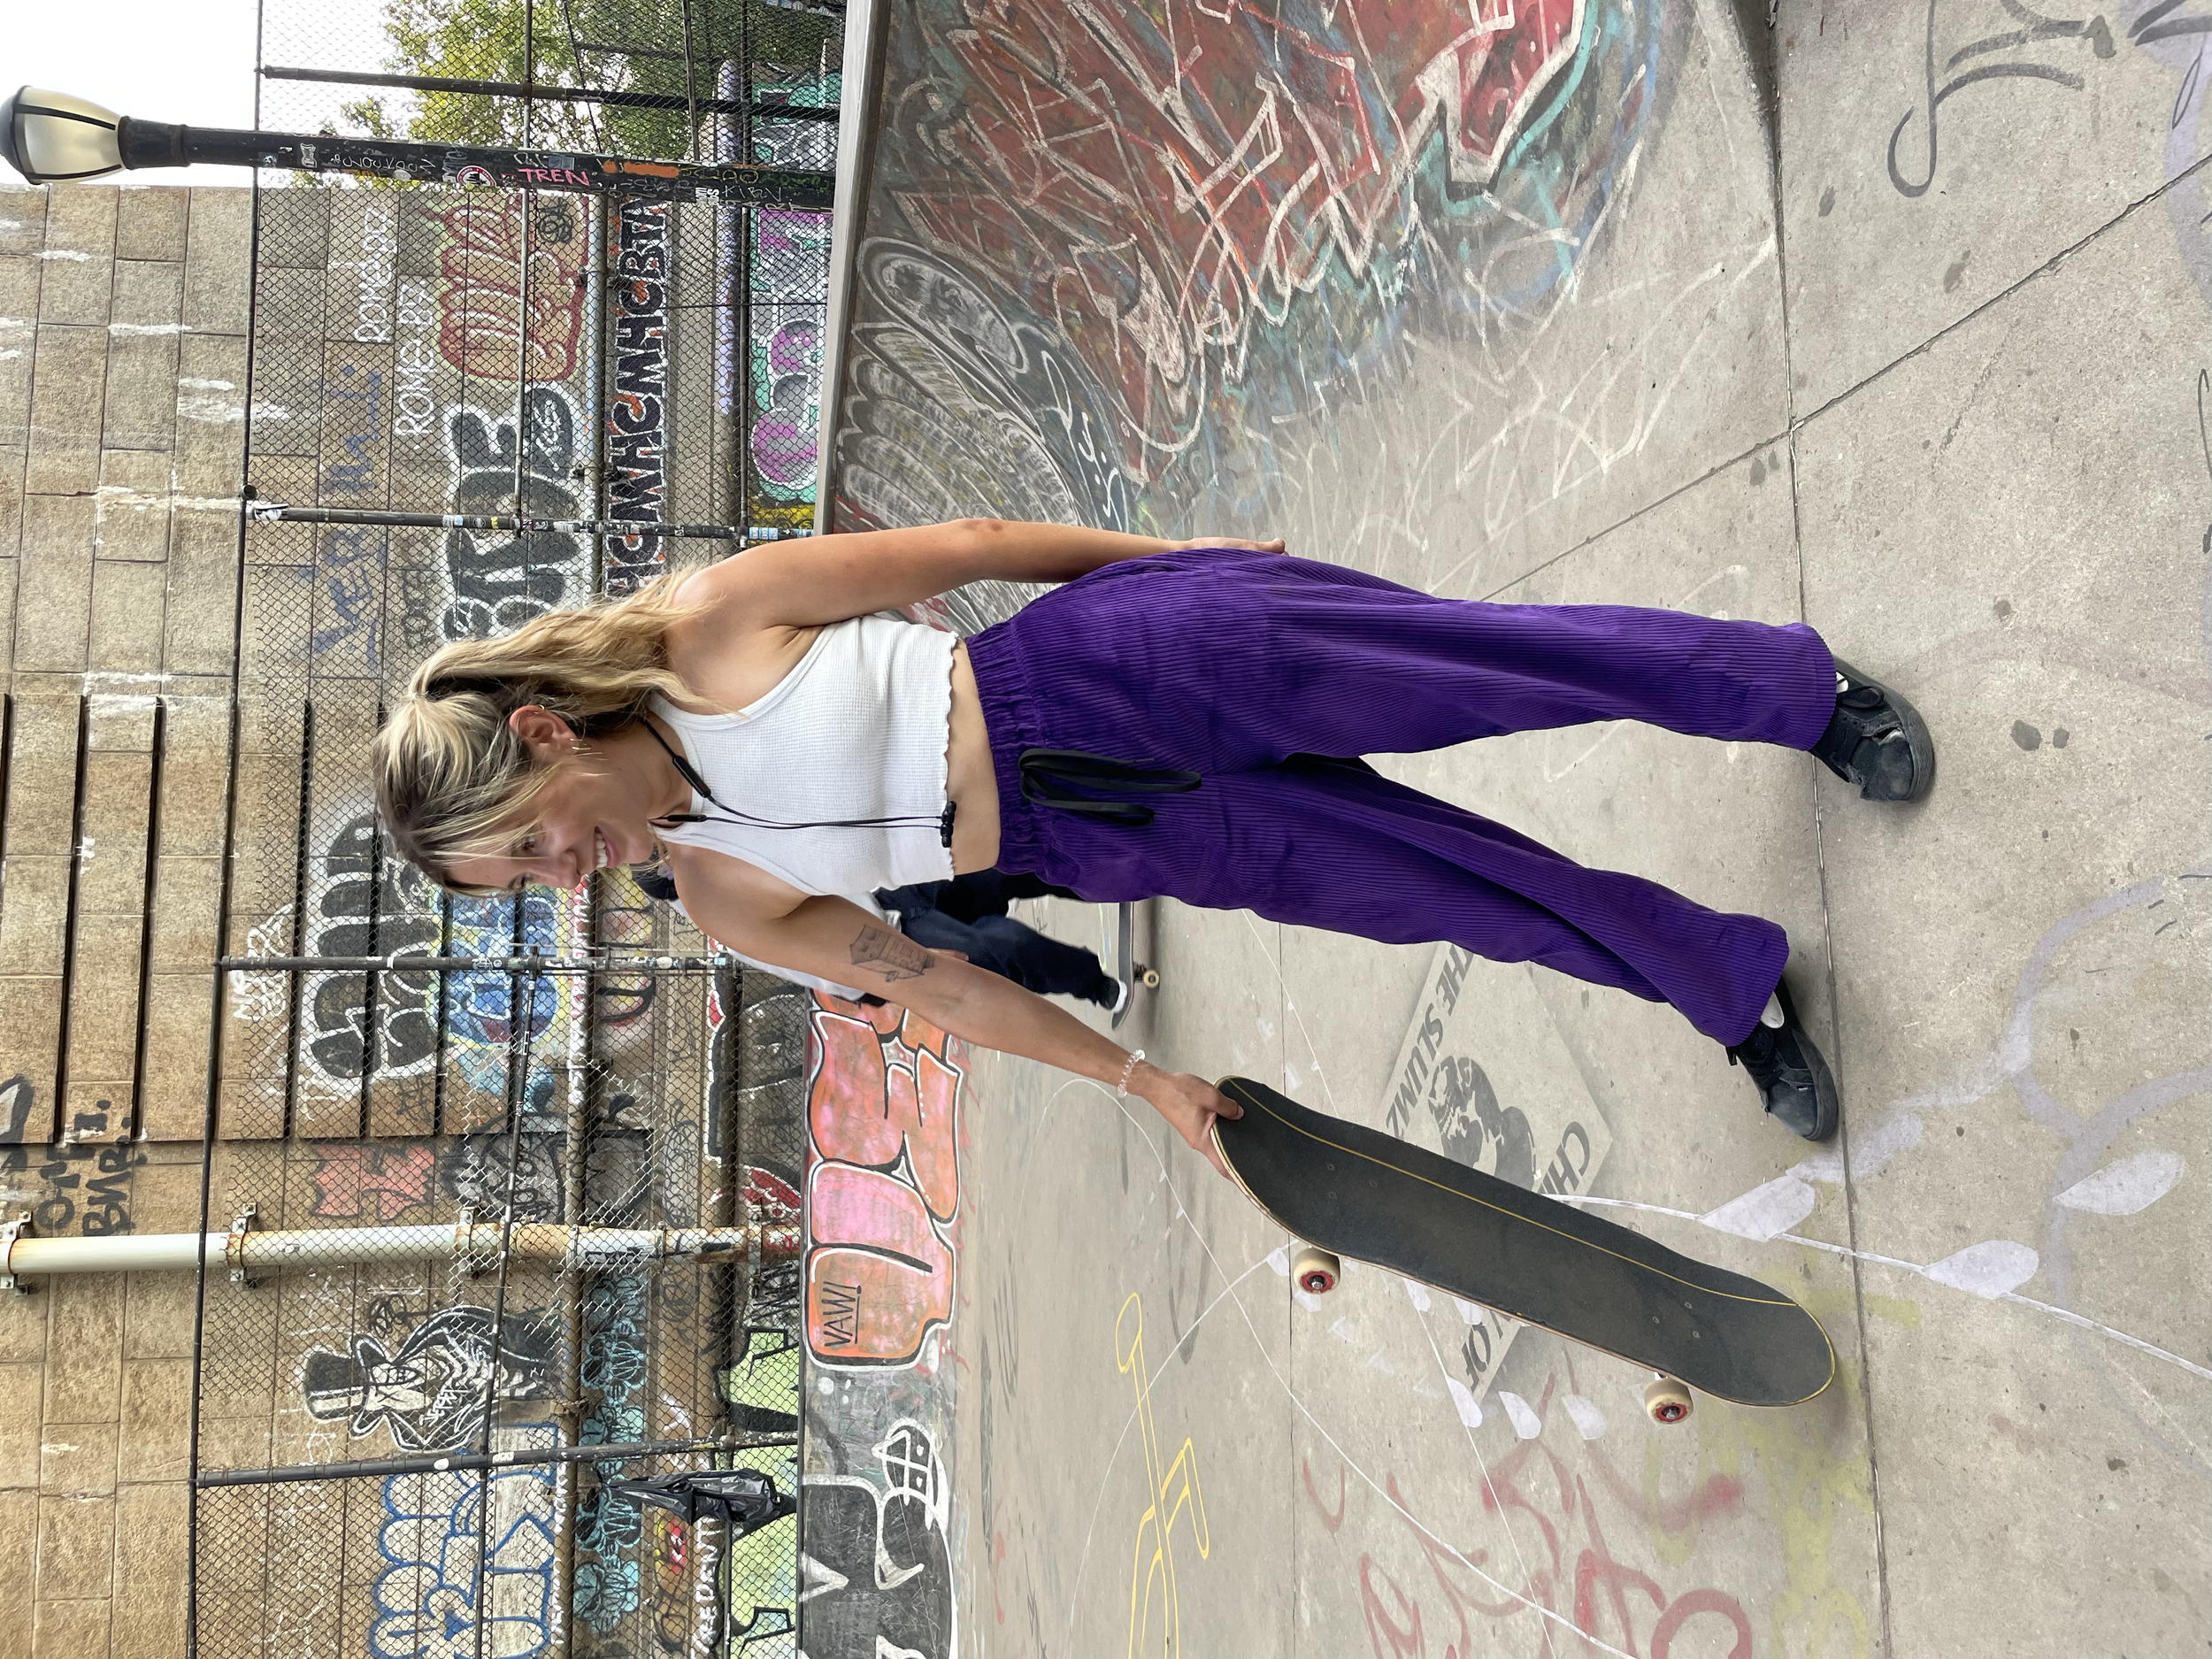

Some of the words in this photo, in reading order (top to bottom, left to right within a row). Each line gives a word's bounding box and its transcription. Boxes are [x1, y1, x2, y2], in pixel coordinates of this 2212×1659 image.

[517, 167, 590, 187] TREN
[1434, 943, 1475, 1016] THE
[1461, 1321, 1492, 1394] OF
